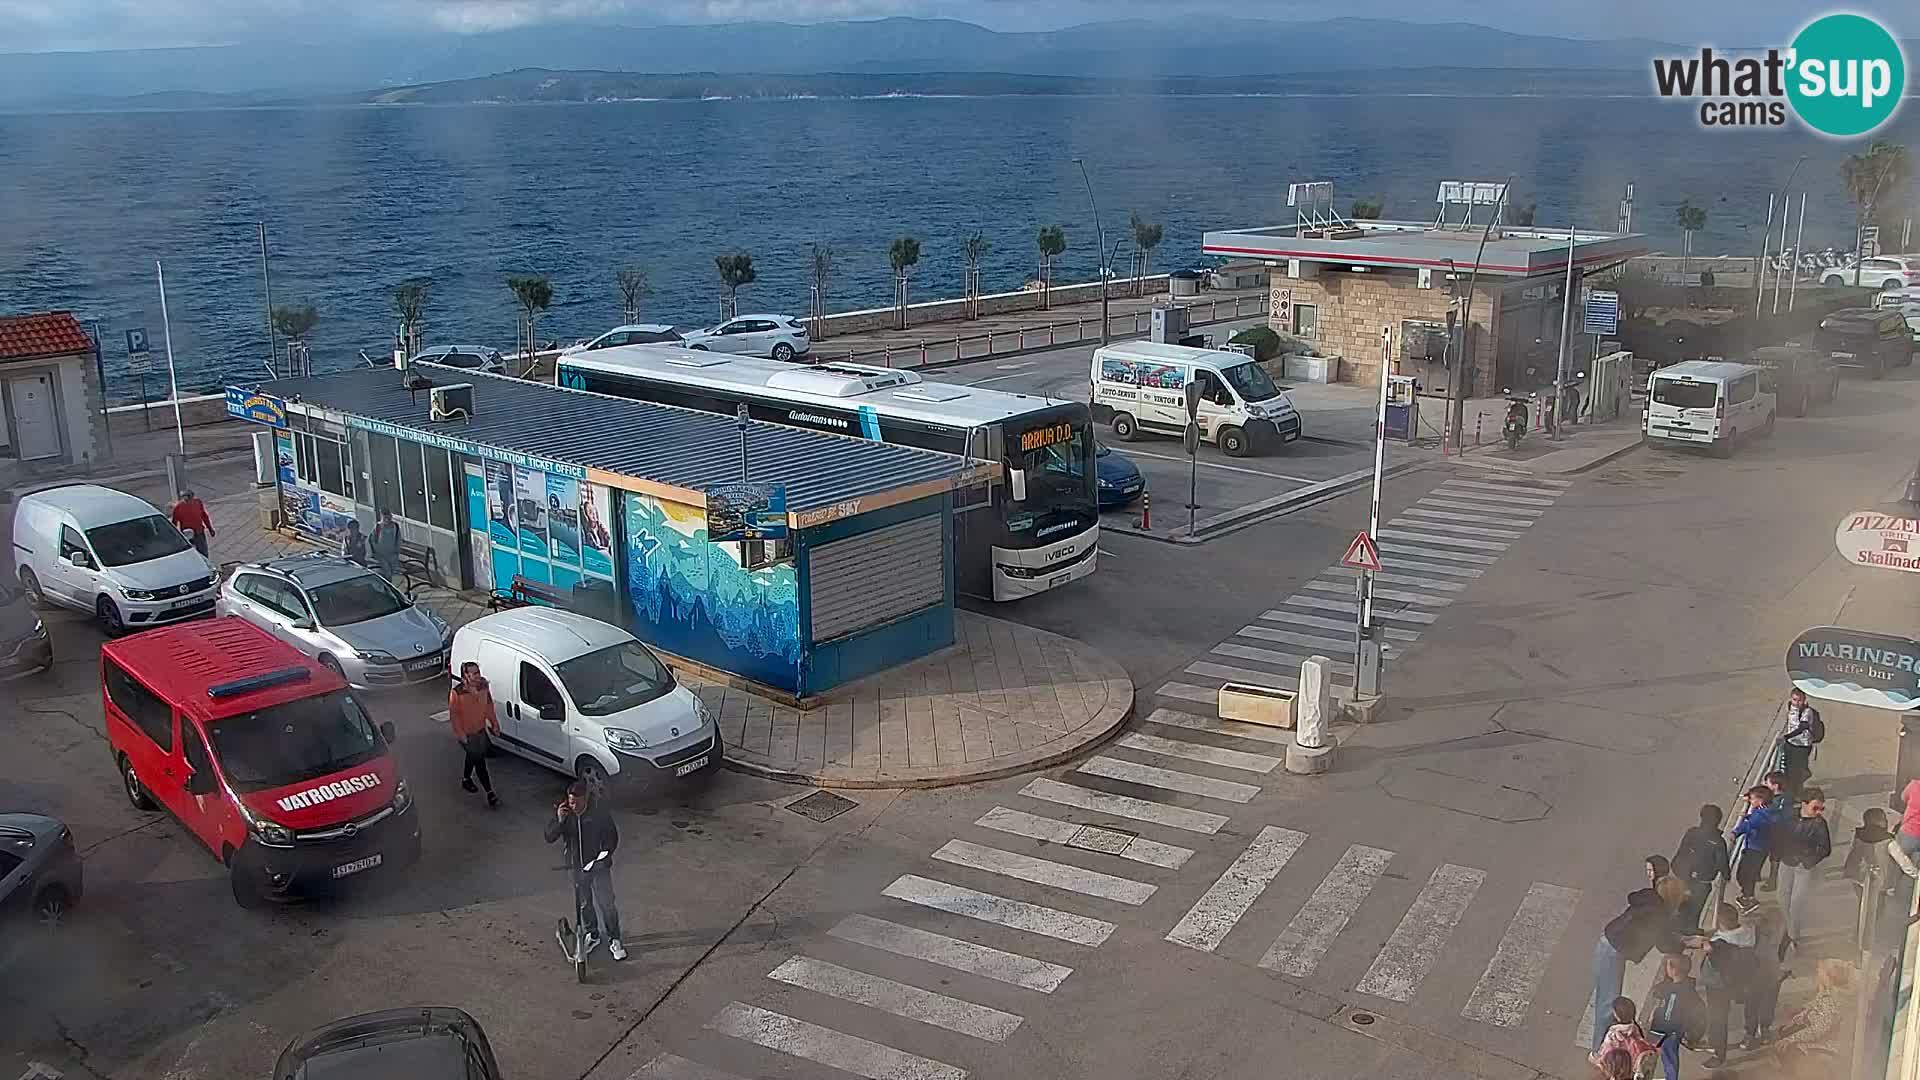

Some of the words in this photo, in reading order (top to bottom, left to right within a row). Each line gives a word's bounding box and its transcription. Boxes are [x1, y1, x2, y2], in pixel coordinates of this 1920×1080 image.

[1021, 427, 1054, 451] ARRIVA
[396, 427, 436, 445] AUTOBUSNA
[437, 436, 468, 452] POSTAJA
[478, 446, 493, 458] BUS
[494, 449, 526, 465] STATION
[528, 456, 555, 471] TICKET
[556, 462, 582, 477] OFFICE
[1045, 545, 1076, 562] IVECO
[1868, 665, 1895, 681] bar
[277, 772, 381, 812] VATROGASCI
